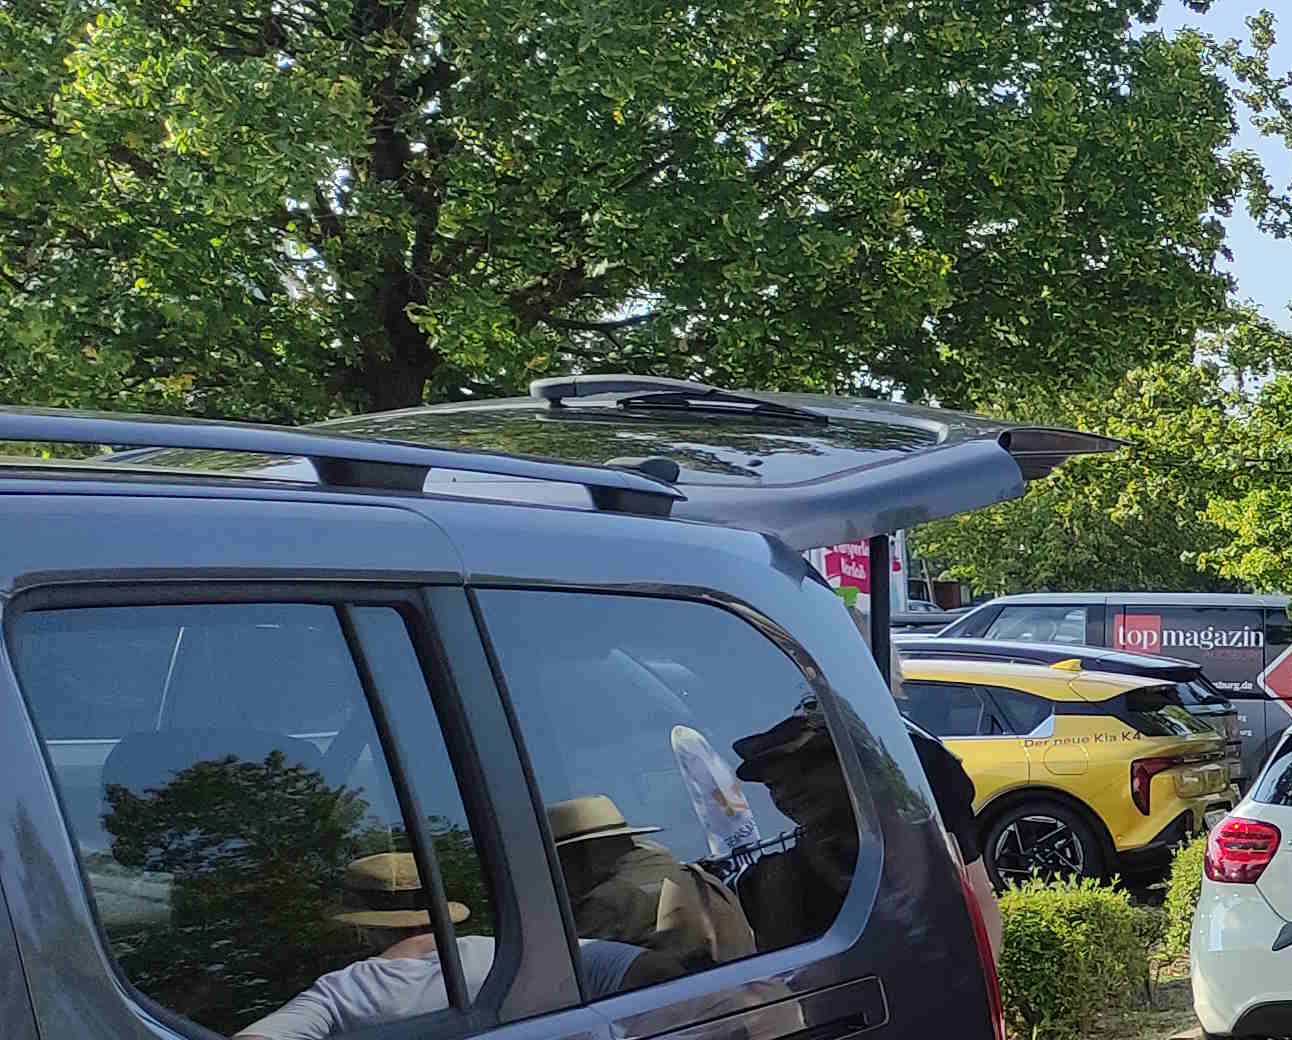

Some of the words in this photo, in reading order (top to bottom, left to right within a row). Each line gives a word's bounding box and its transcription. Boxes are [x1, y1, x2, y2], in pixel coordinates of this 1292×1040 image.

[1118, 624, 1158, 650] top
[1162, 625, 1264, 650] magazin
[1094, 732, 1117, 743] Kia
